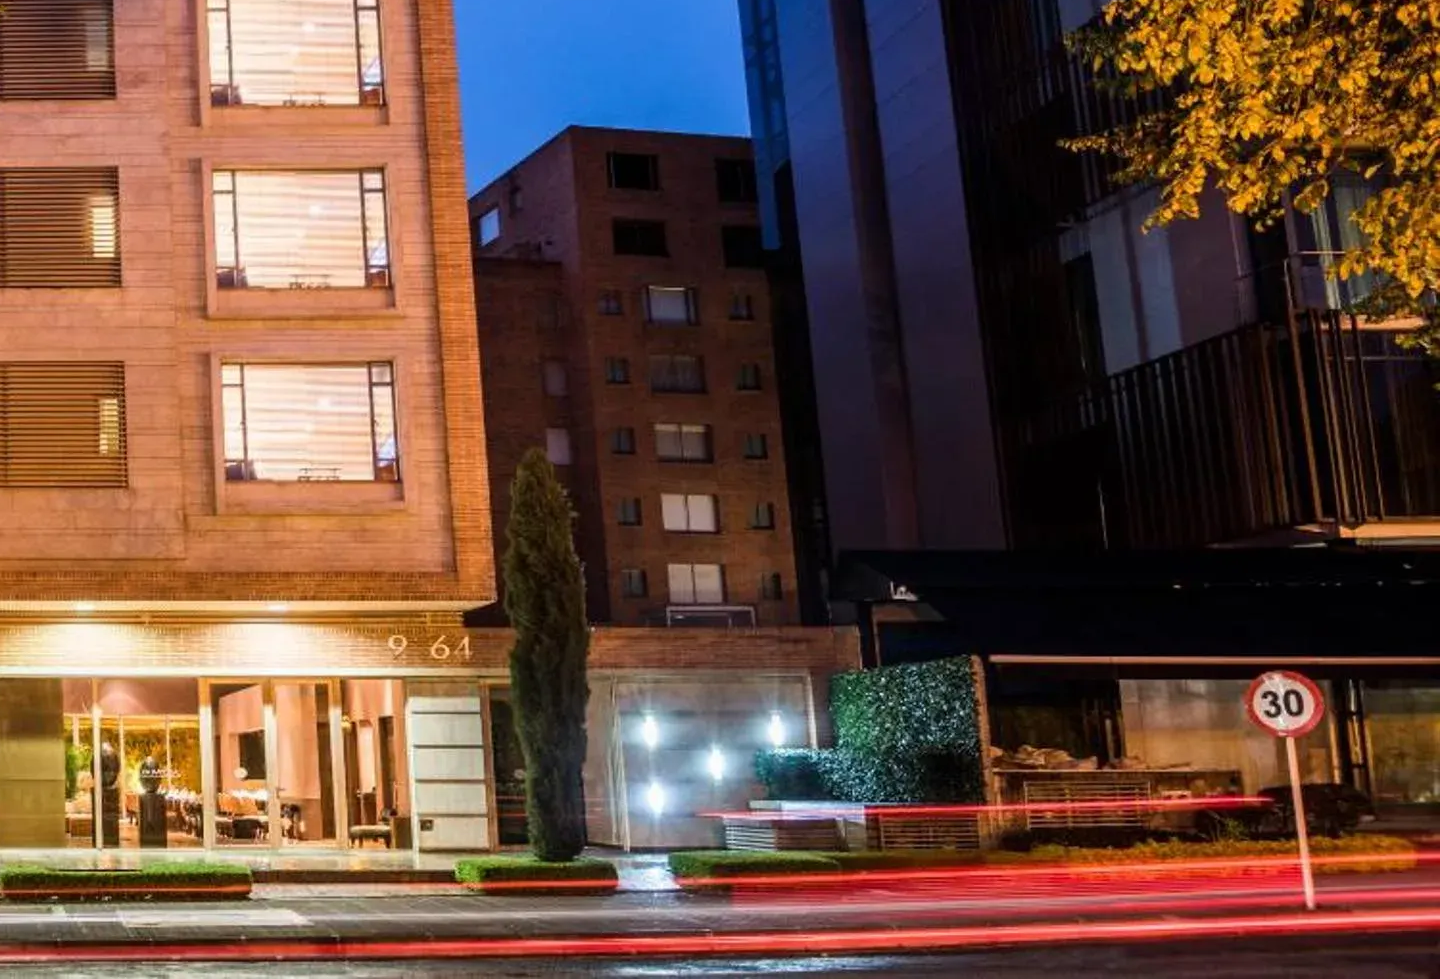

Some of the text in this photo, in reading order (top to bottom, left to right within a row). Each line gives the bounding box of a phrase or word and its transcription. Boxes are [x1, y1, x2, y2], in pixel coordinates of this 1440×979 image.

[387, 634, 473, 660] 9 64
[1261, 689, 1305, 718] 30
